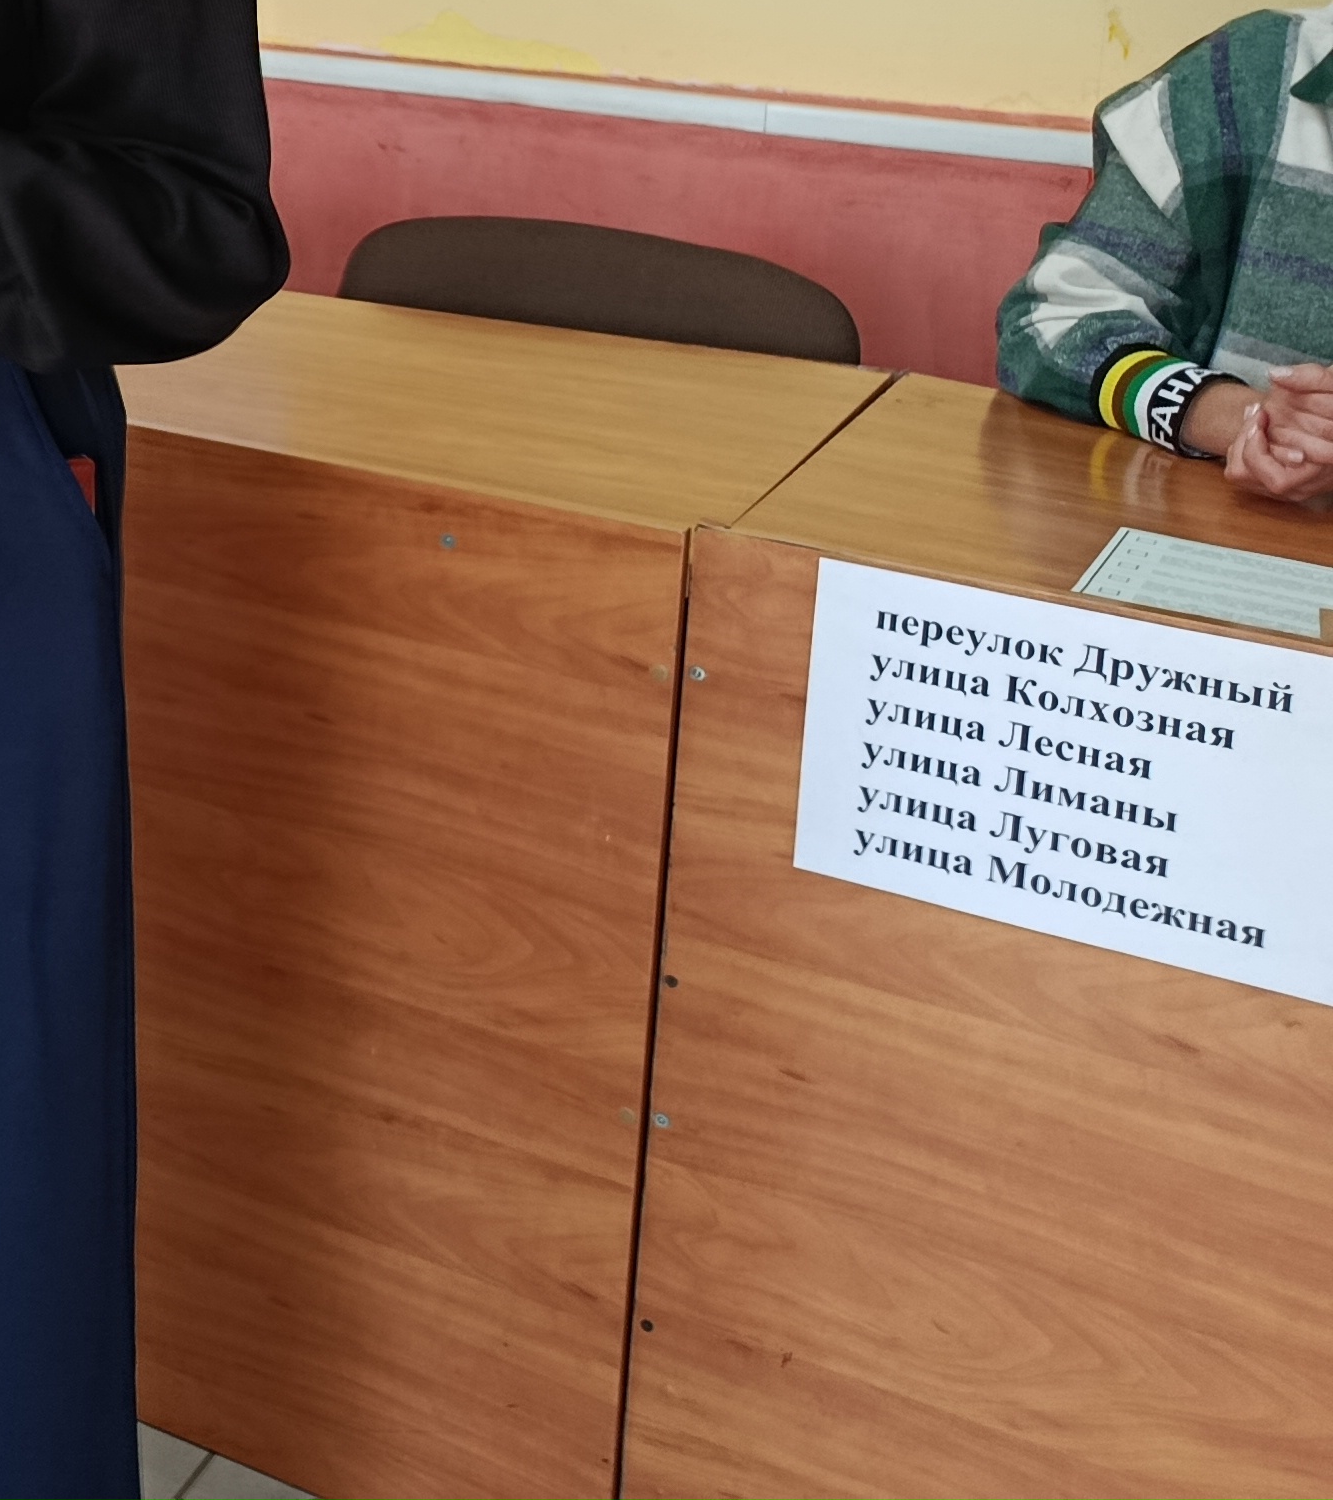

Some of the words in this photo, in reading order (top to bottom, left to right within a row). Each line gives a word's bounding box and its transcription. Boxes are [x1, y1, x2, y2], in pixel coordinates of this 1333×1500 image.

[870, 652, 990, 698] улица
[1004, 674, 1236, 750] Колхозная
[876, 609, 1064, 667] переулок
[1073, 643, 1294, 714] Дружный
[860, 740, 981, 787] улица
[993, 765, 1178, 833] Лиманы
[865, 697, 986, 743] улица
[998, 720, 1153, 780] Лесная
[856, 784, 977, 832] улица
[988, 811, 1169, 878] Луговая
[853, 827, 973, 876] улица
[986, 854, 1267, 949] Молодежная
